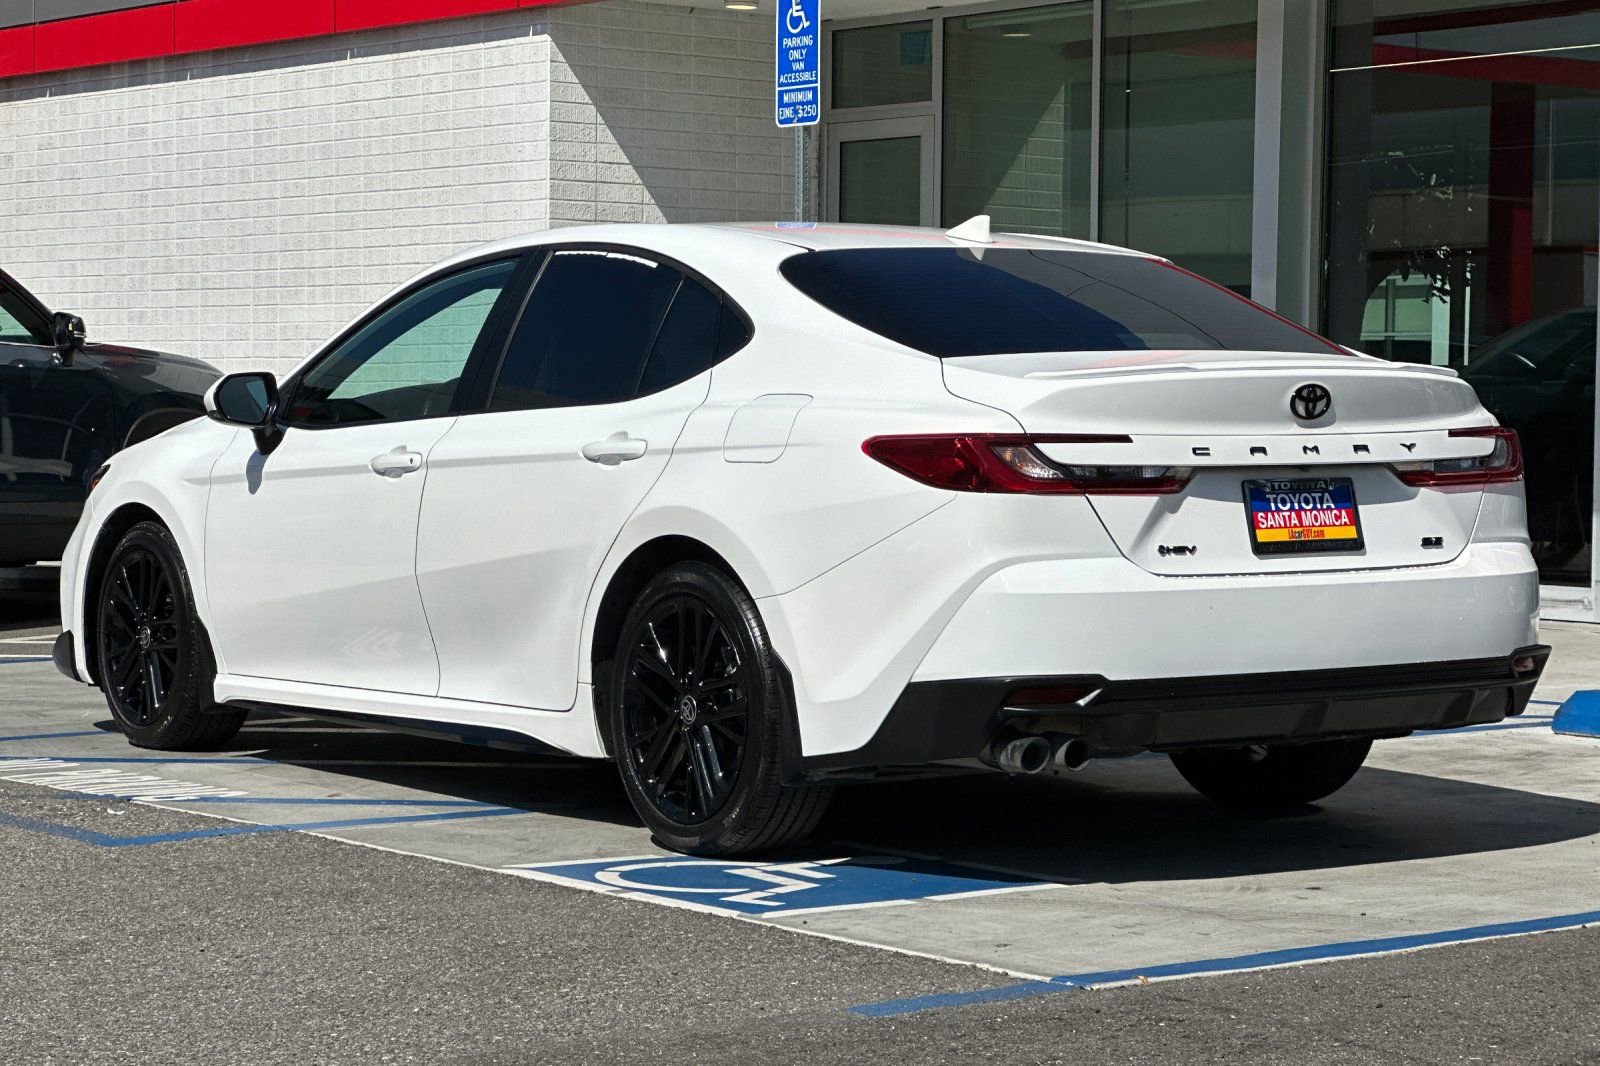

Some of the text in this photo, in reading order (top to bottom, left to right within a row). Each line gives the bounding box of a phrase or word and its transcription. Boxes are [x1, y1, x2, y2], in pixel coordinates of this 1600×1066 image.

[782, 35, 813, 49] PARKING
[788, 48, 807, 60] ONLY
[791, 61, 805, 71] VAN
[779, 71, 817, 83] ACCESSIBLE
[783, 90, 813, 104] MINIMUM
[779, 104, 817, 119] FINE $250
[1191, 443, 1417, 456] CAMRY
[1266, 492, 1335, 511] TOYOTA
[1257, 509, 1350, 529] SANTA MONICA
